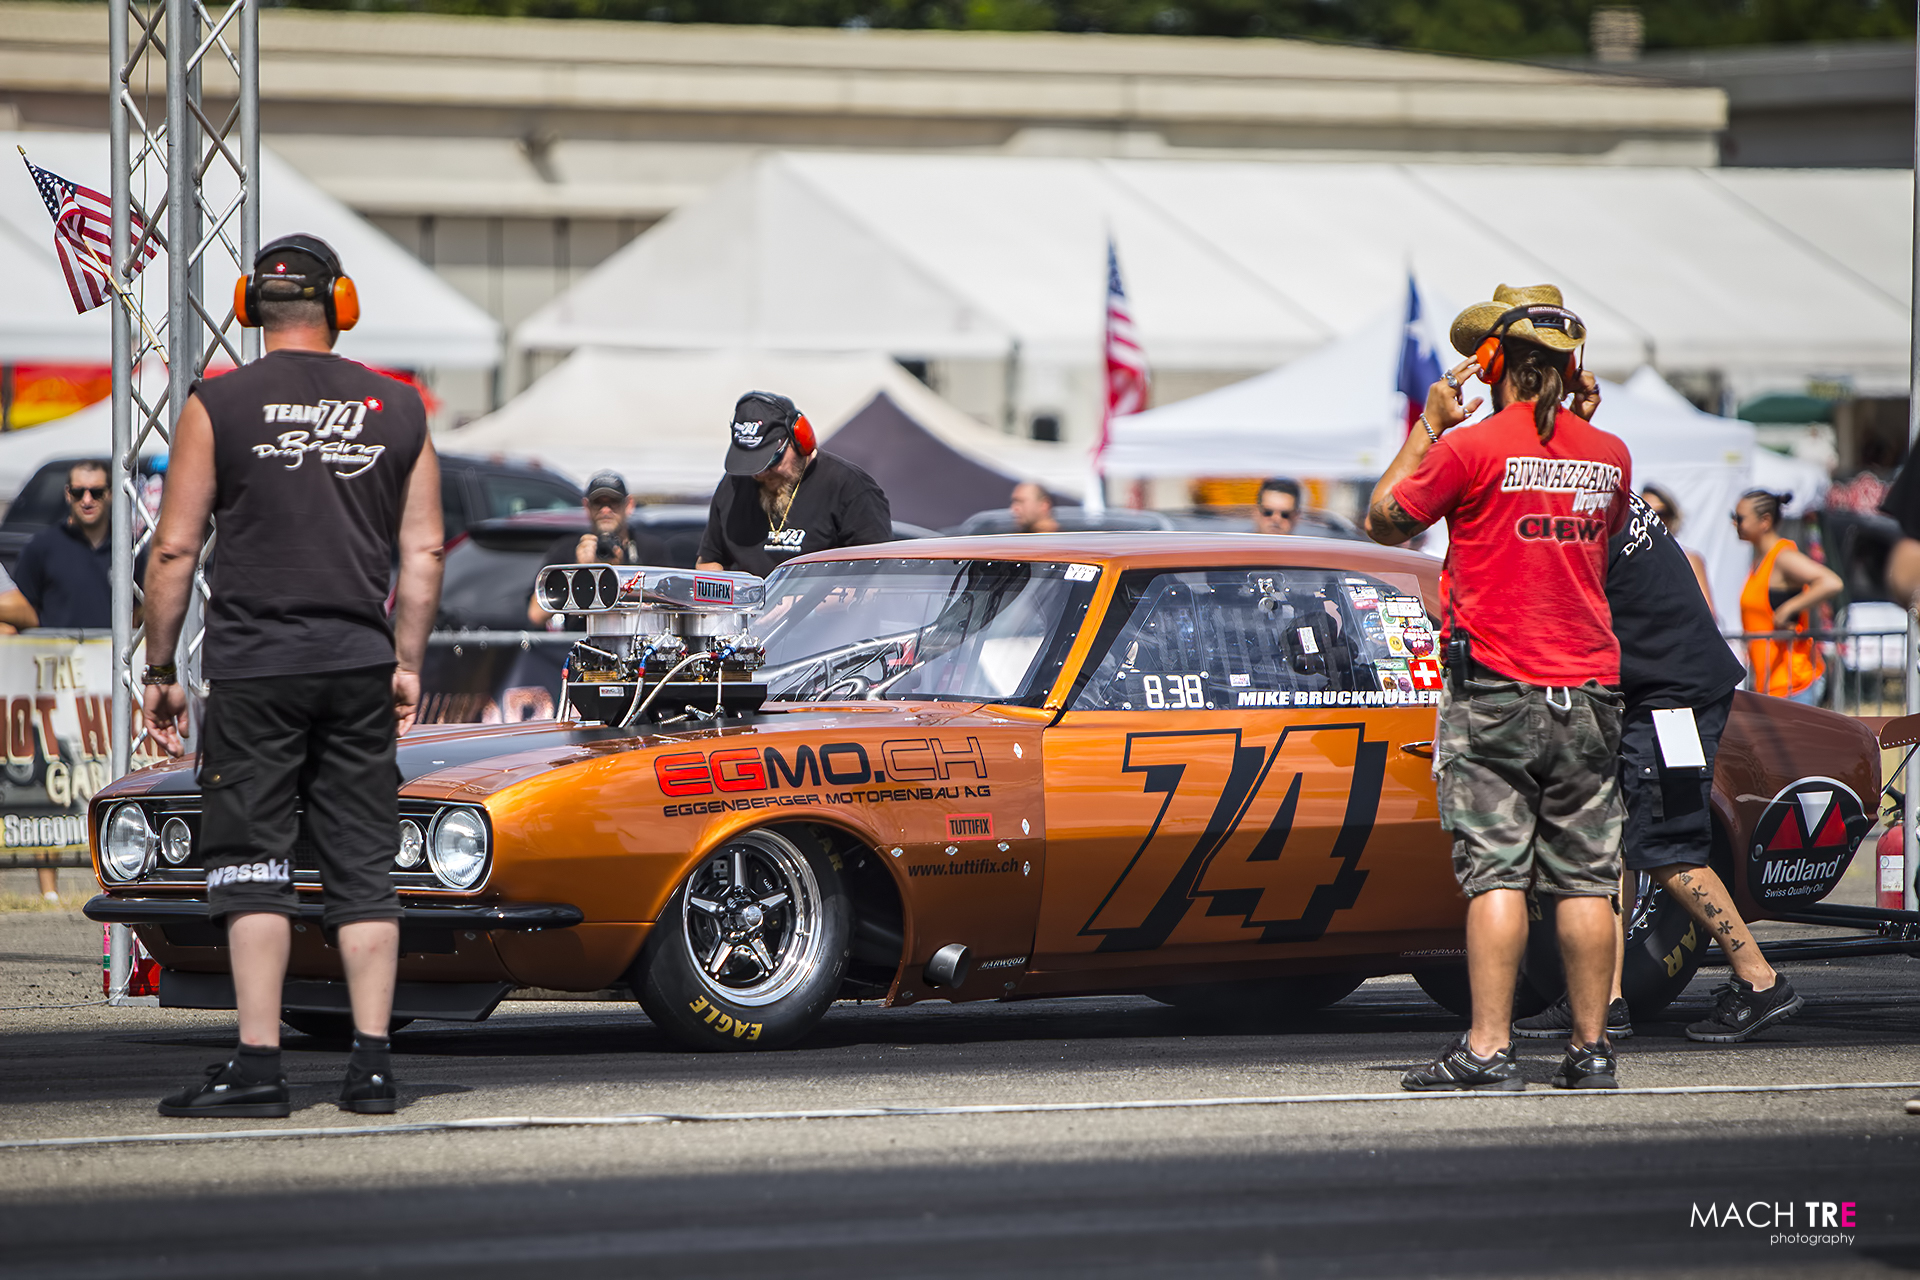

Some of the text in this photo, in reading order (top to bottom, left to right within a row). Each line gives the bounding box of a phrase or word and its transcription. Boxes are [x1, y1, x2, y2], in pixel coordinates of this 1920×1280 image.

[263, 399, 367, 439] TEAM 74
[696, 581, 731, 599] TUTTIFIX
[34, 654, 87, 691] THE
[1143, 674, 1203, 709] 8.38
[1237, 691, 1289, 706] MIKE
[653, 736, 988, 797] EGMO.CH
[663, 785, 991, 817] EGGENBERGER MOTORENBAU AG
[949, 818, 990, 836] TUTTIFIX
[1076, 722, 1390, 954] 74
[908, 857, 1019, 877] www.tuttifix.ch
[1761, 854, 1841, 885] Midland
[1765, 888, 1787, 898] Swiss
[1787, 886, 1813, 896] Quality
[689, 994, 764, 1041] EAGLE
